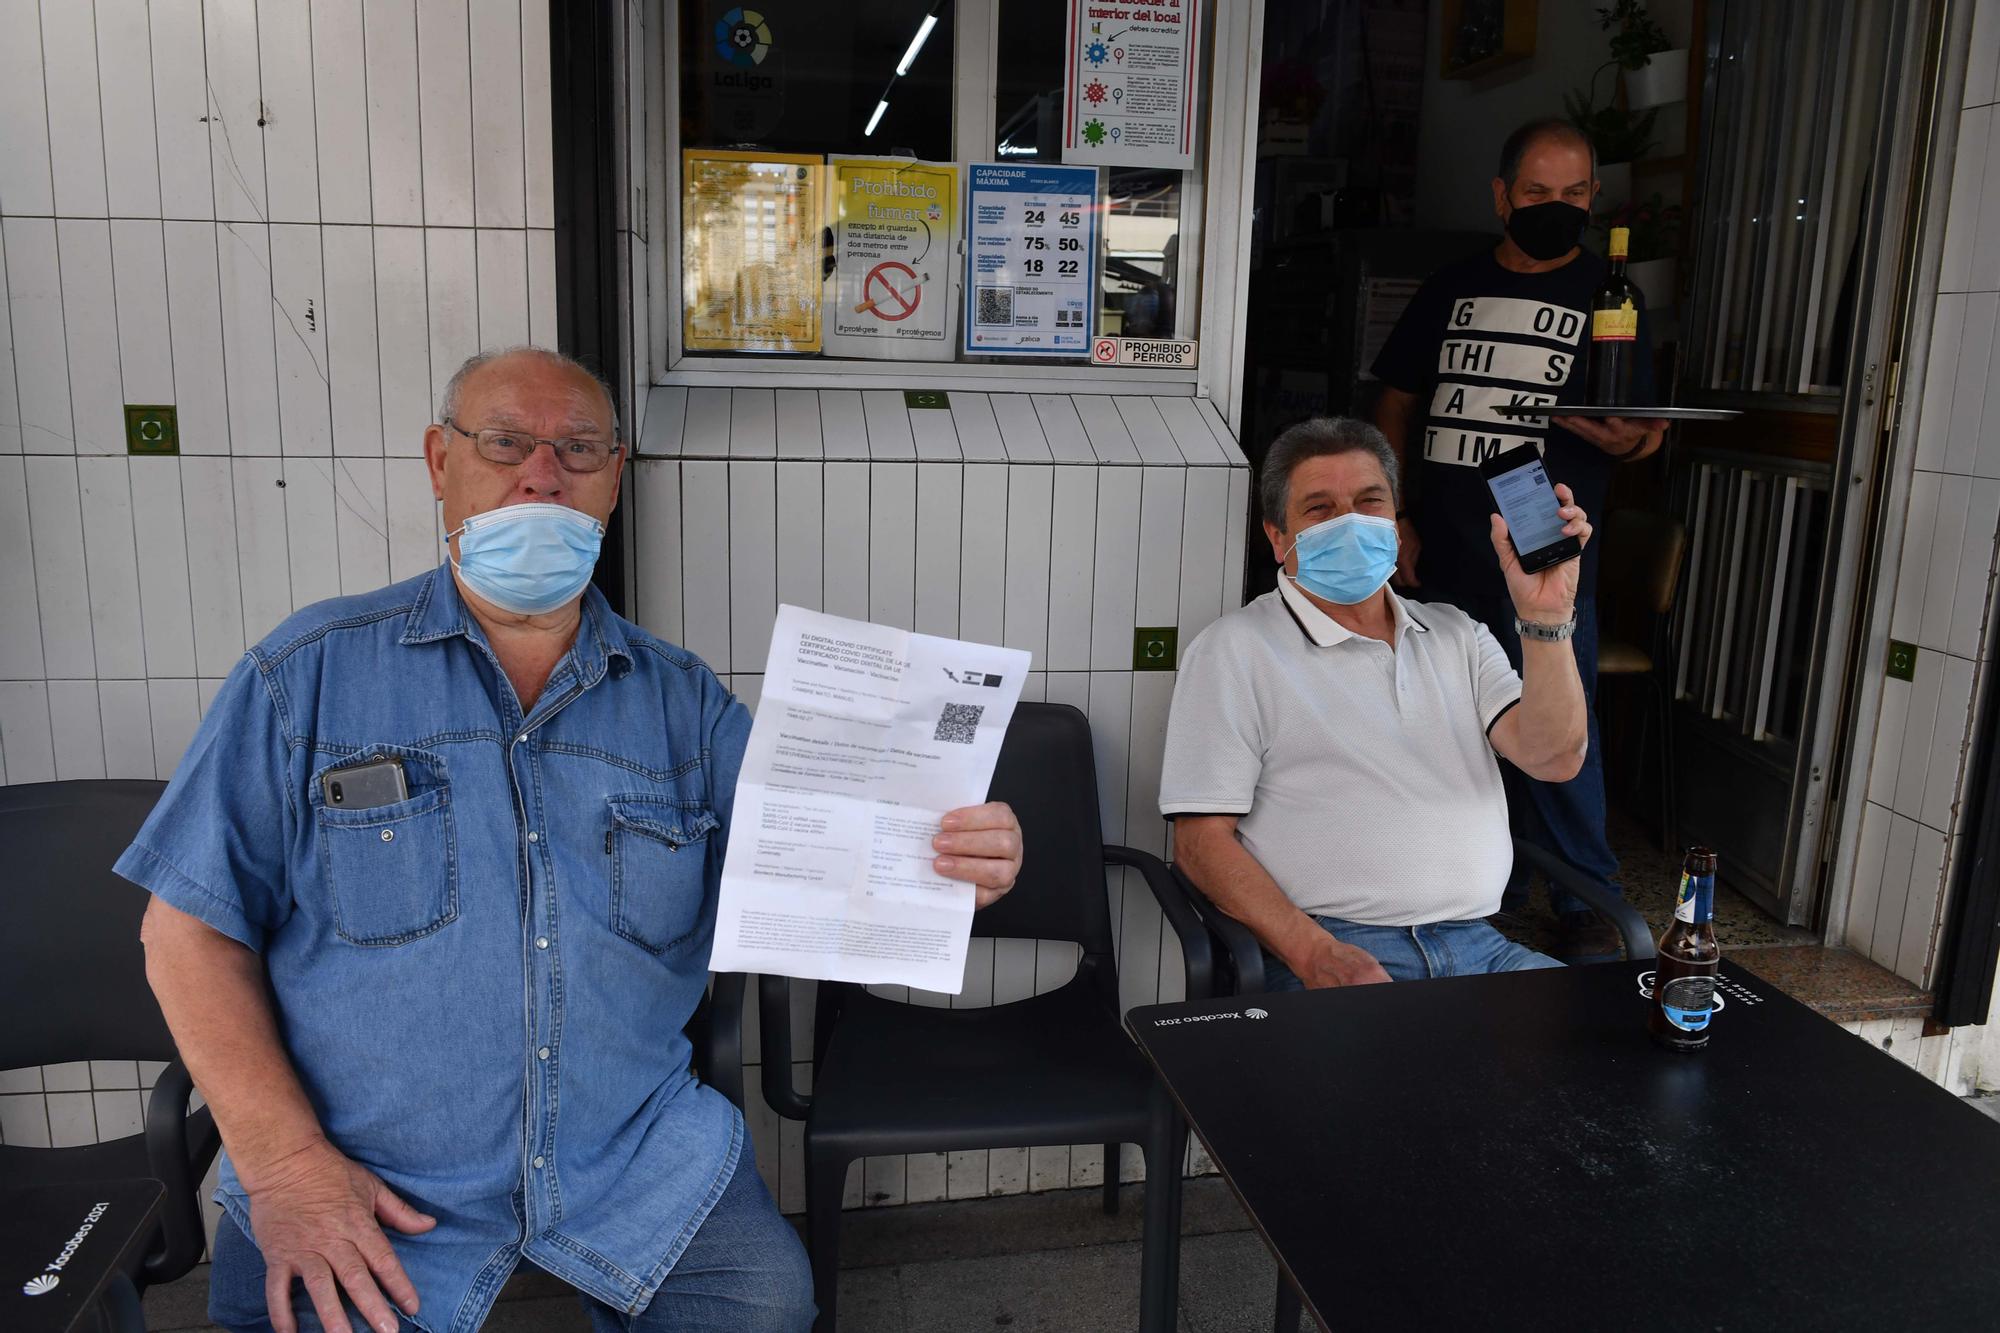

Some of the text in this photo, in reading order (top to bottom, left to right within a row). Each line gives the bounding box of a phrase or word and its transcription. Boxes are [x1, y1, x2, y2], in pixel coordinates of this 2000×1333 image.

[1088, 6, 1180, 24] interior del local
[714, 71, 772, 90] LaLiga
[976, 169, 1026, 178] CAPACIDADE
[852, 176, 937, 199] Prohibido
[976, 177, 1010, 186] MÁXIMA
[868, 202, 921, 221] fumar
[1024, 210, 1046, 224] 24
[1059, 212, 1080, 225] 45
[863, 232, 896, 240] distancia
[1024, 259, 1044, 272] 18
[1058, 260, 1078, 274] 22
[838, 325, 878, 334] #protégete
[1125, 342, 1191, 354] PROHIBIDO
[1133, 352, 1182, 364] PERROS
[800, 640, 840, 654] CERTIFICADO
[840, 648, 862, 658] COVID
[862, 652, 885, 662] DIGITAL
[811, 634, 834, 645] DIGITAL
[836, 640, 856, 649] COVID
[856, 644, 893, 656] CERTIFICATE
[798, 648, 839, 660] CERTIFICADO
[840, 656, 860, 664] COVID
[1154, 1012, 1242, 1026] Xacobeo 2021
[44, 1202, 110, 1271] Xacobeo 2021
